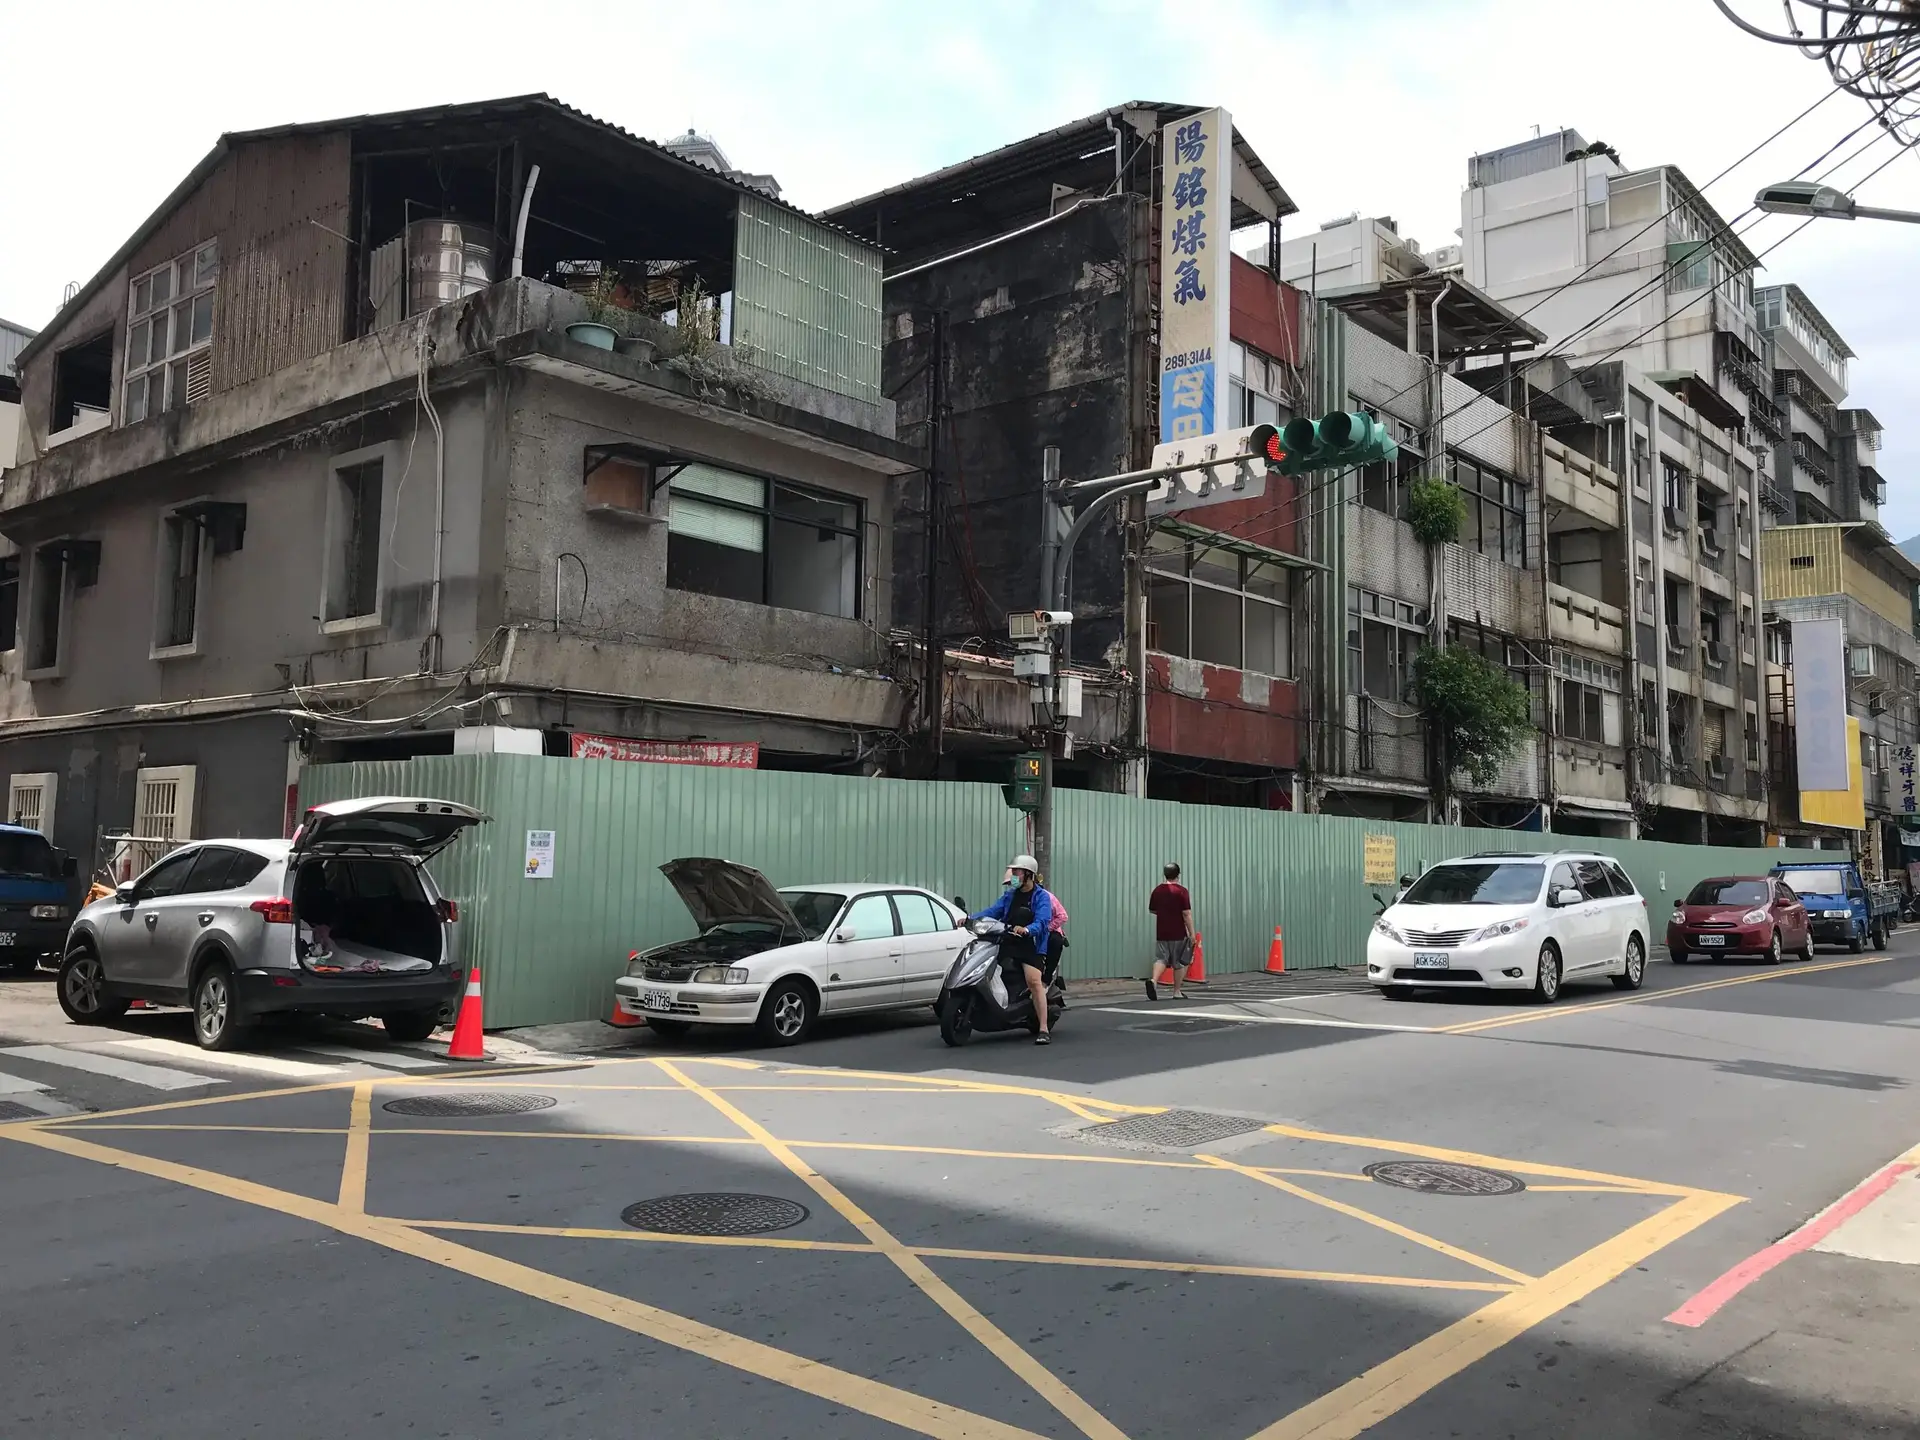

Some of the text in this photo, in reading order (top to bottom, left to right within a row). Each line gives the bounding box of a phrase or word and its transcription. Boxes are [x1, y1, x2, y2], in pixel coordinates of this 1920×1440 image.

[1172, 120, 1208, 306] 陽銘煤氣
[1165, 347, 1212, 371] 2891-3144
[1029, 760, 1039, 776] 4
[1897, 745, 1919, 812] 德祥牙醫
